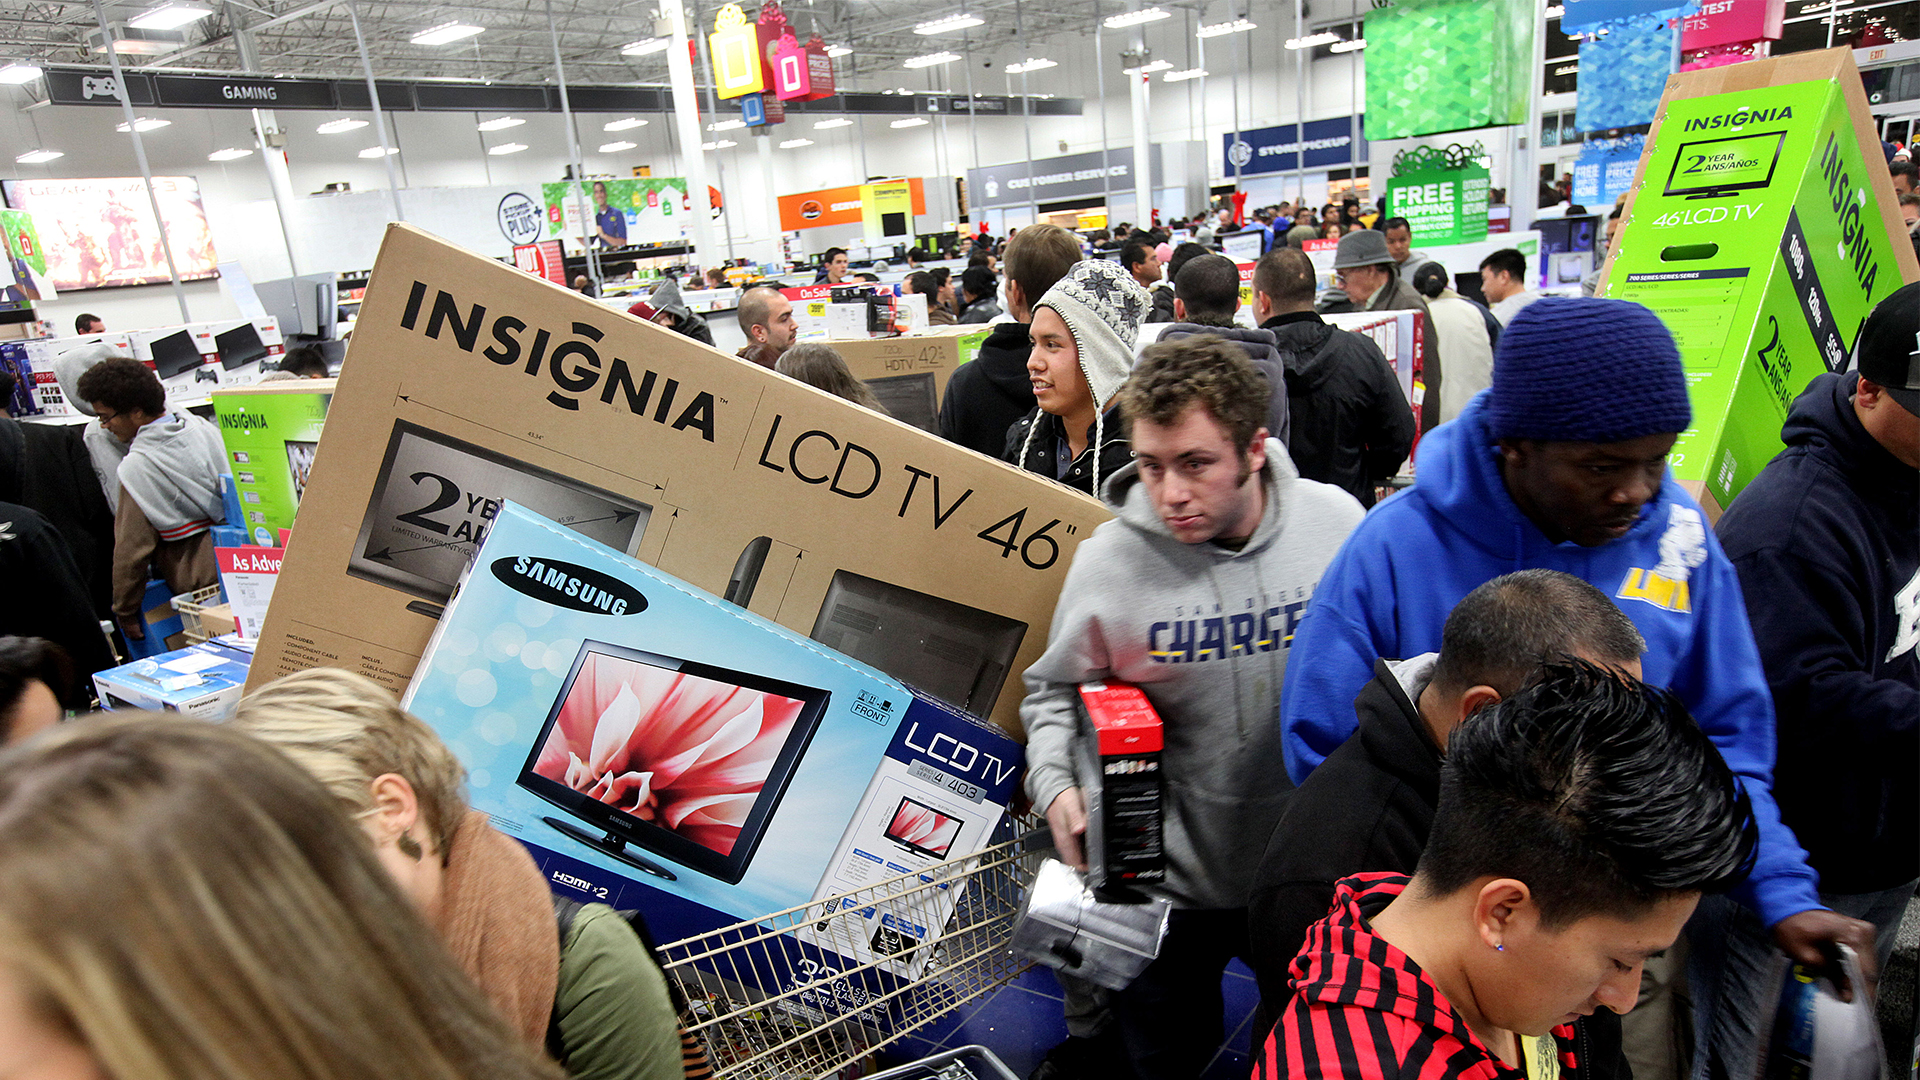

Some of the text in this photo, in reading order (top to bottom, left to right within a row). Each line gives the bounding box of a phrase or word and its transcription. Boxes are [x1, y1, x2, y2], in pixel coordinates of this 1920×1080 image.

[1870, 50, 1884, 60] EXIT
[222, 85, 278, 100] GAMING
[1684, 105, 1793, 133] INSIGNIA
[1258, 135, 1351, 157] STORE PICKUP
[1682, 153, 1735, 175] 2 YEAR
[1703, 158, 1760, 173] ANS/AÑOS
[1006, 164, 1128, 190] CUSTOMER SERVICE
[1392, 181, 1455, 207] FREE
[1393, 202, 1455, 218] SHIPPING
[1683, 206, 1729, 225] LCD
[1733, 202, 1764, 222] TV
[1820, 130, 1879, 304] INSIGNIA
[508, 214, 536, 237] PLUS
[515, 247, 539, 271] HOT
[1789, 233, 1805, 280] 1080p
[800, 287, 832, 299] On Sale
[1807, 286, 1824, 328] 120Hz
[918, 345, 939, 365] 42
[1757, 315, 1793, 382] 2 YEAR
[400, 280, 715, 443] INSIGNIA
[885, 359, 914, 371] HDTV
[220, 411, 269, 431] INSIGNIA
[757, 413, 1078, 571] LCD TV 46"
[395, 471, 462, 536] 2
[391, 524, 421, 541] LIMITED
[232, 553, 250, 571] As
[513, 554, 628, 617] SAMSUNG
[1175, 603, 1222, 617] SAN
[286, 633, 315, 646] INCLUDED:
[284, 649, 319, 663] AUDIO CABLE
[286, 641, 339, 661] COMPONENT CABLE
[279, 664, 292, 672] AAA
[282, 656, 304, 668] REMOTE
[376, 675, 394, 684] AUDIO
[188, 695, 221, 710] Panasonic
[854, 703, 887, 723] FRONT
[903, 721, 1017, 787] LCD TV
[934, 772, 944, 783] 4
[947, 779, 978, 800] 403
[608, 814, 633, 830] SAMSUNG
[552, 870, 591, 891] HDMI
[835, 981, 867, 998] CLASS
